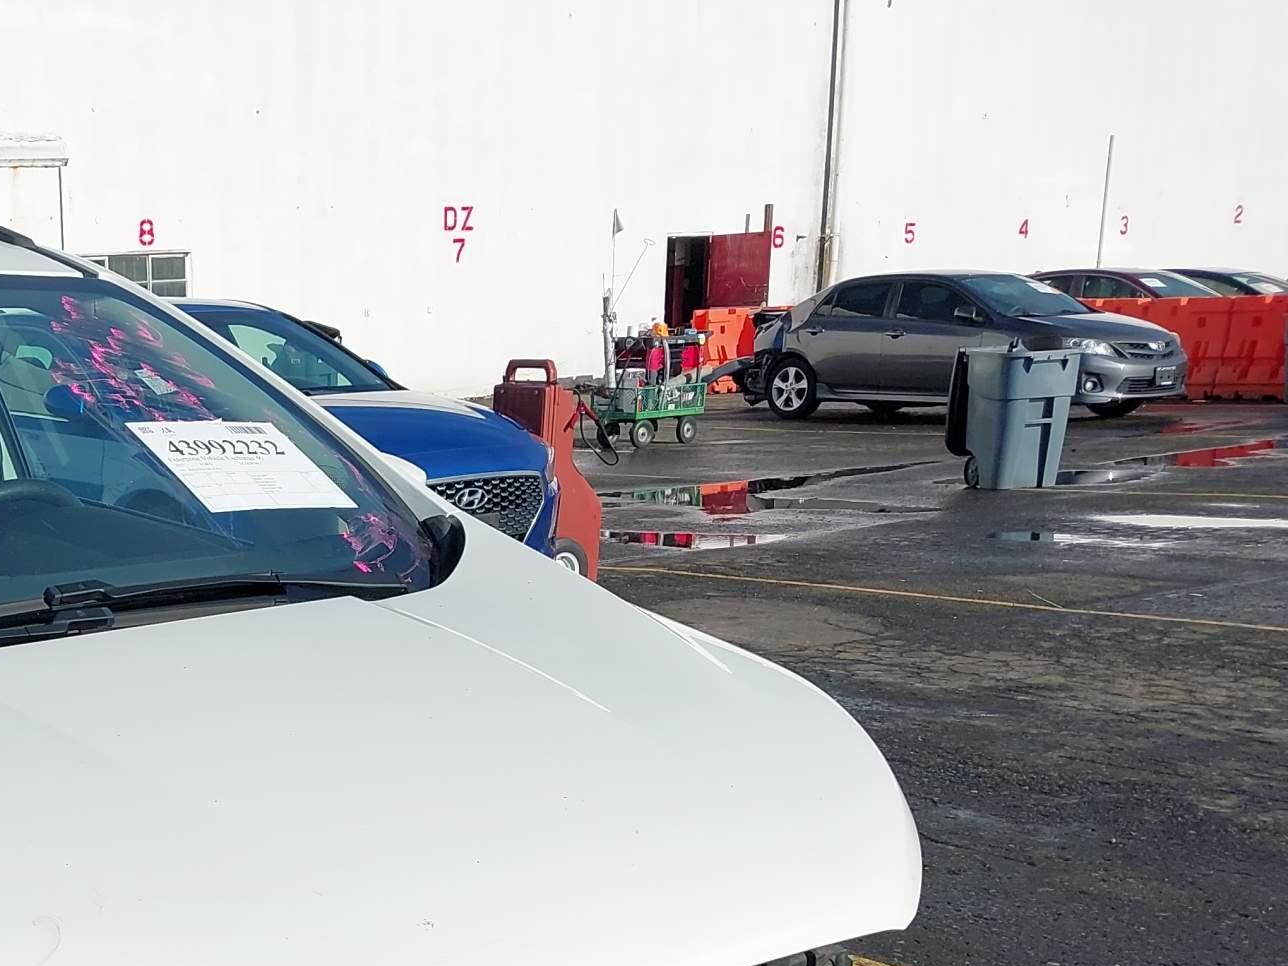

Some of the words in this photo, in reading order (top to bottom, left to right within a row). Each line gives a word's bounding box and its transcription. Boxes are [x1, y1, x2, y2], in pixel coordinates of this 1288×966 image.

[443, 206, 474, 231] DZ
[1119, 215, 1129, 235] 3
[1233, 204, 1244, 224] 2
[138, 218, 156, 247] 8
[772, 225, 785, 249] 6
[904, 222, 917, 244] 5
[1018, 218, 1030, 238] 4
[452, 238, 466, 263] 7
[168, 438, 286, 456] 43992232
